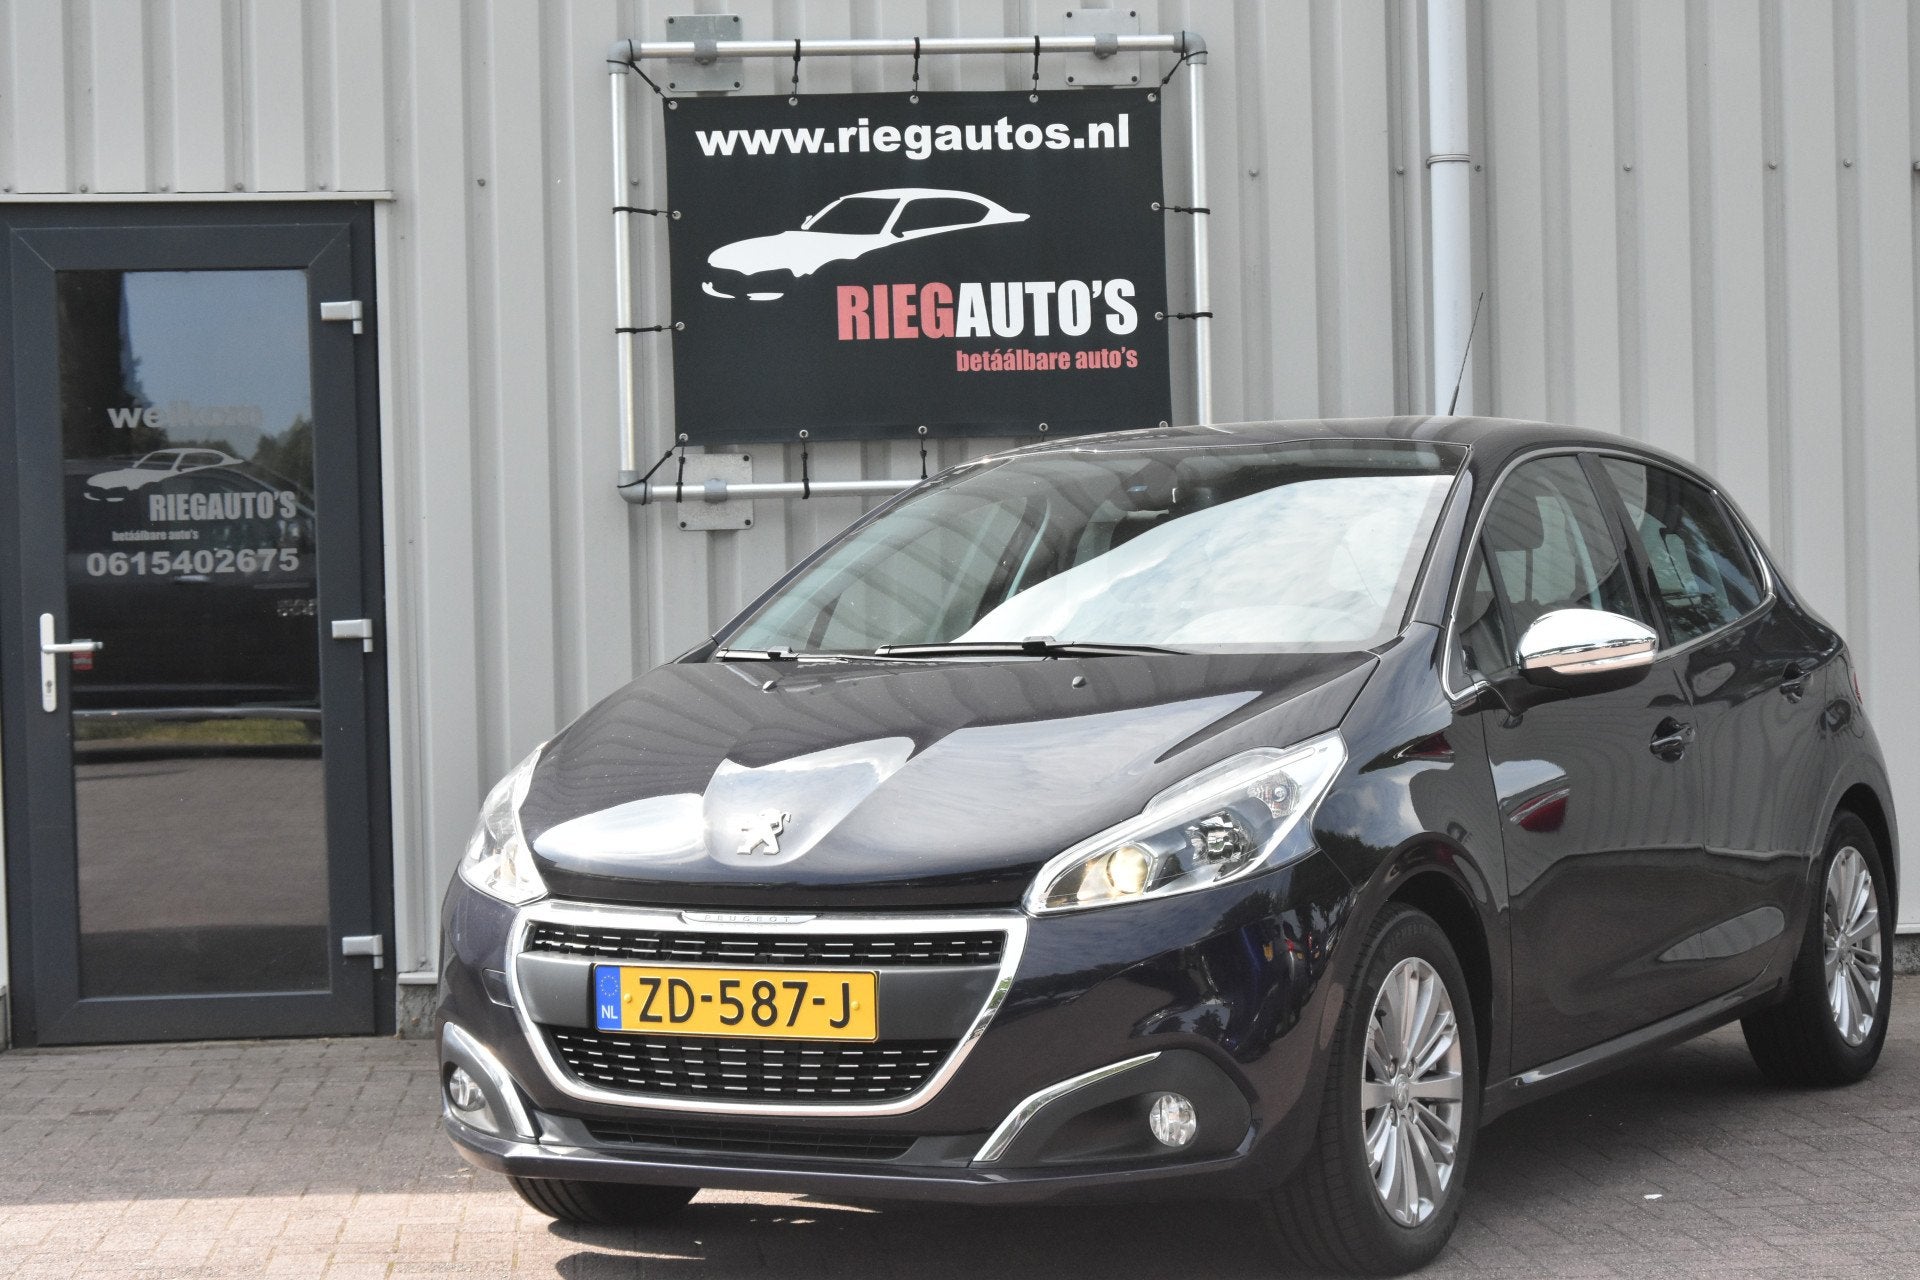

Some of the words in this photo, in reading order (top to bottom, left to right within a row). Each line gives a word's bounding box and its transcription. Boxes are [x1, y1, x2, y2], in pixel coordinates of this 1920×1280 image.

[695, 113, 1130, 161] www.riegautos.nl
[836, 278, 1139, 341] RIEGAUTO'S
[956, 348, 1071, 372] betáálbare
[1075, 346, 1139, 370] auto's
[149, 490, 297, 522] RIEGAUTO'S
[86, 548, 300, 577] 0615402675
[704, 913, 791, 923] PEUGEOT
[601, 1003, 618, 1020] NL
[638, 976, 851, 1029] ZD-587-J
